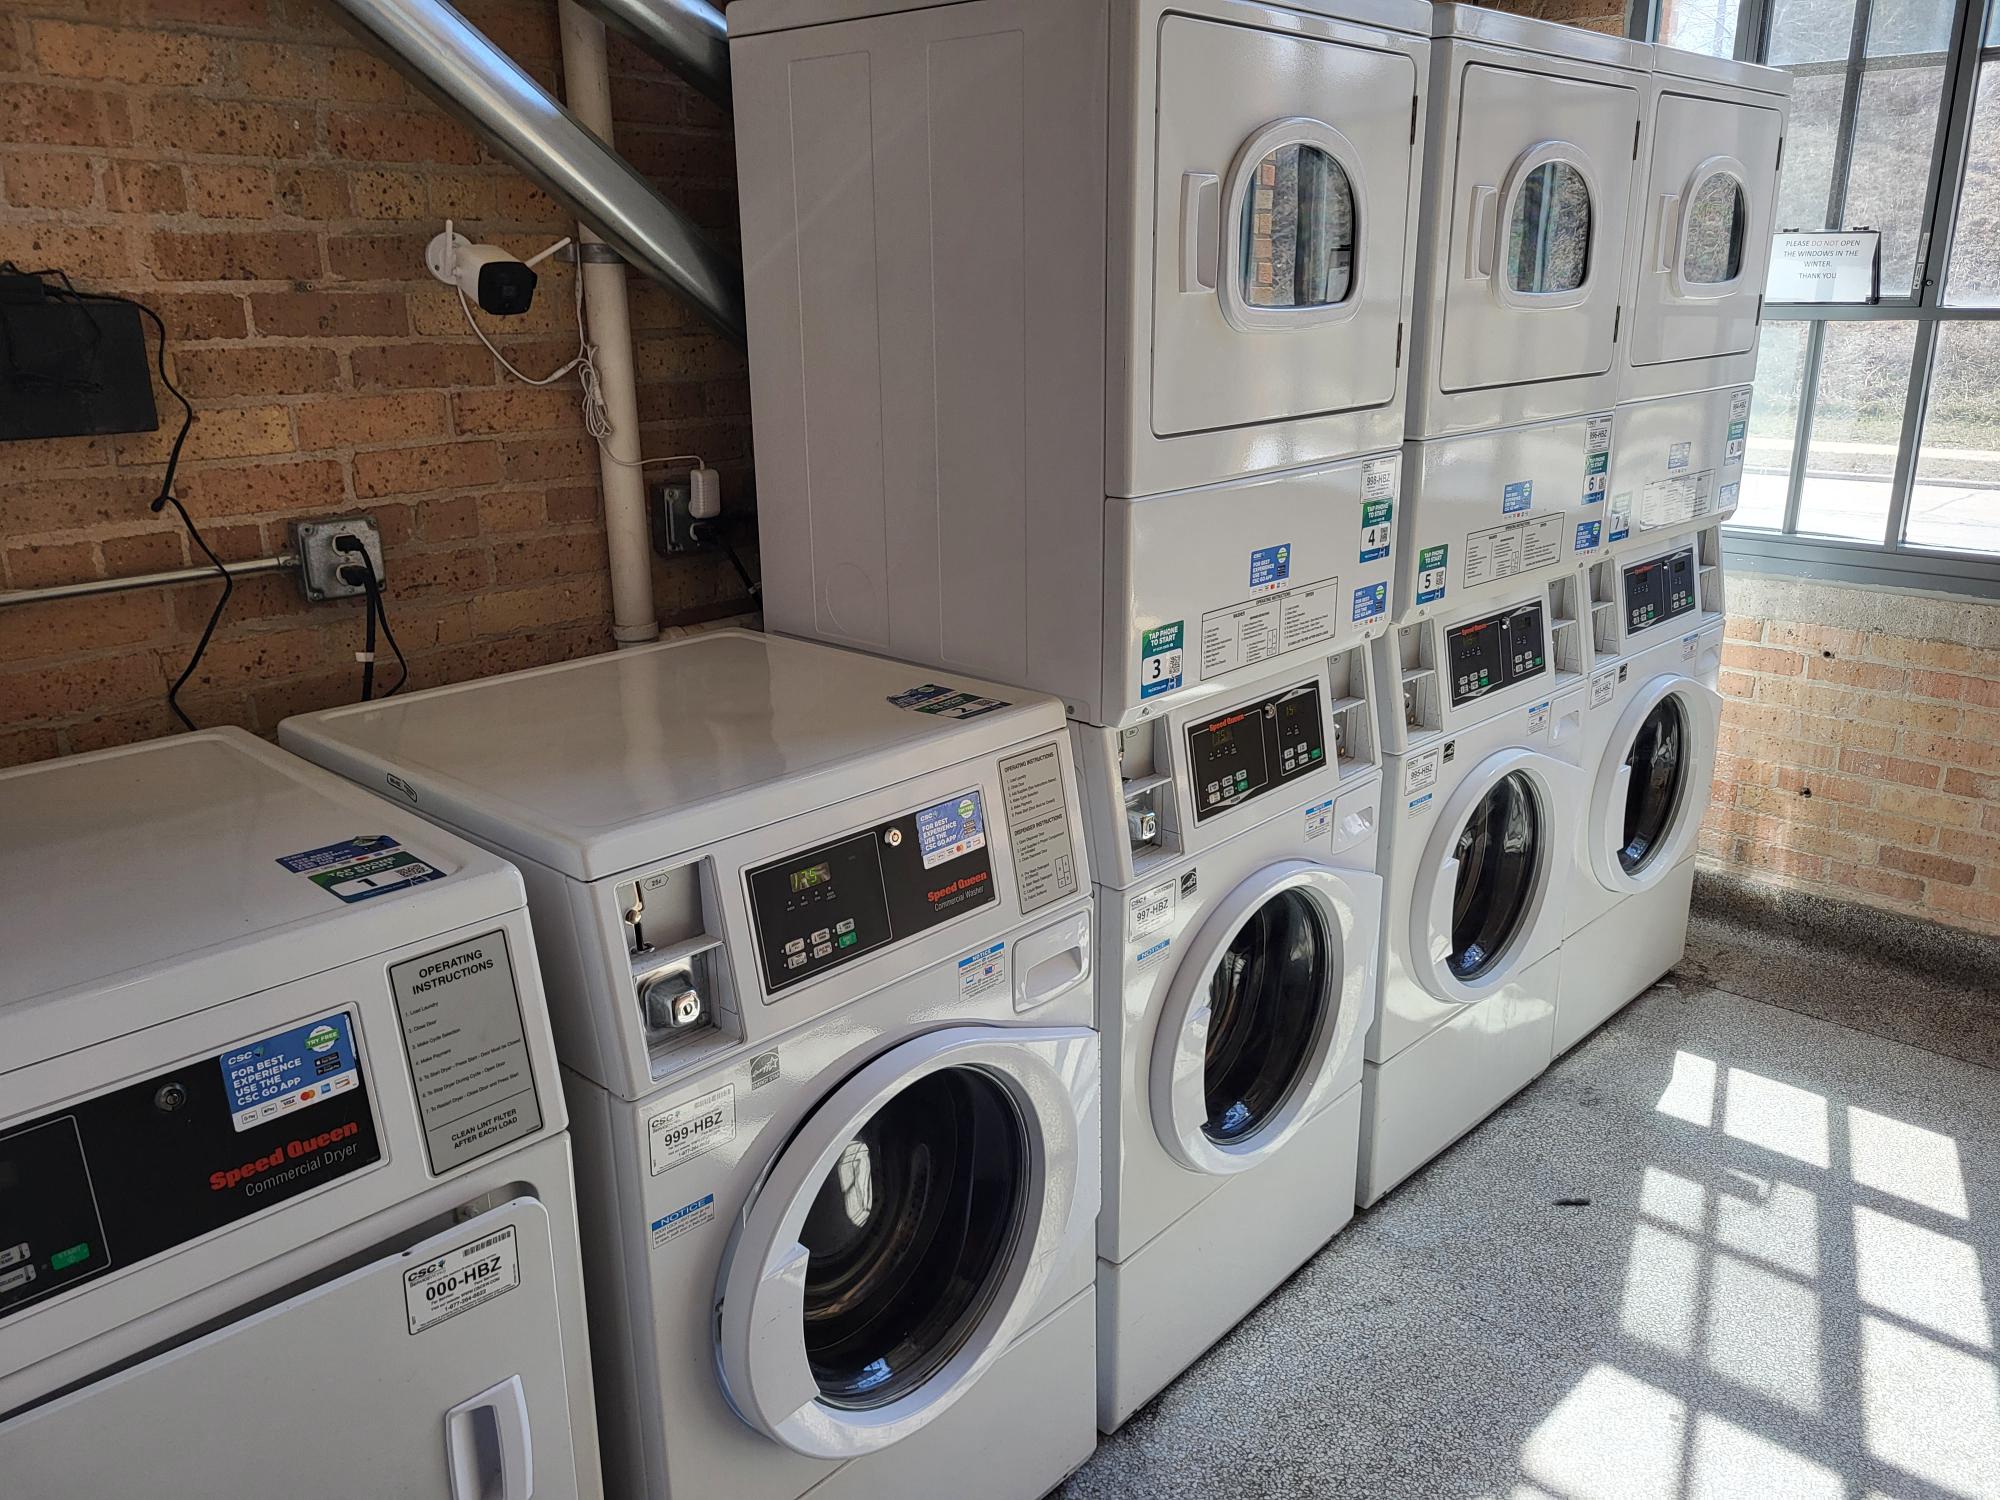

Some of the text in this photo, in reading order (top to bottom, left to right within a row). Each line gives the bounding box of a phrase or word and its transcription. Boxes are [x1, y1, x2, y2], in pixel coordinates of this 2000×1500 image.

[1730, 442, 1734, 454] 8
[1588, 477, 1594, 491] 6
[1616, 516, 1620, 530] 7
[1368, 529, 1375, 546] 4
[1425, 574, 1431, 589] 5
[1149, 626, 1178, 640] TAP PHONE
[1151, 634, 1176, 647] TO START
[1152, 658, 1161, 679] 3
[1209, 714, 1245, 732] Speed Queen
[1004, 752, 1054, 772] OPERATING INSTRUCTIONS
[922, 818, 948, 832] FOR BEST
[923, 821, 957, 839] EXPERIENCE
[1014, 814, 1063, 836] DISPENSER INSTRUCTIONS
[924, 831, 947, 845] USE THE
[925, 835, 957, 851] CSC GO APP
[355, 862, 395, 874] START
[356, 878, 378, 888] 1
[927, 871, 987, 902] Speed Queen
[934, 886, 984, 912] Commercial Washer
[1137, 898, 1169, 922] 997-HBZ
[418, 949, 483, 979] OPERATING
[412, 959, 494, 995] INSTRUCTIONS
[306, 1031, 337, 1047] TRY FREE
[228, 1052, 253, 1066] CSC
[231, 1055, 284, 1079] FOR BEST
[233, 1058, 302, 1089] EXPERIENCE
[235, 1075, 282, 1097] USE THE
[237, 1077, 301, 1106] CSC GO APP
[283, 1097, 295, 1106] VISA
[451, 1108, 517, 1142] CLEAN LINT FILTER
[651, 1112, 673, 1129] CSC
[664, 1111, 723, 1147] 999-HBZ
[454, 1117, 518, 1149] AFTER EACH LOAD
[209, 1121, 359, 1191] Speed Queen
[245, 1142, 358, 1197] Commercial Dryer
[661, 1199, 706, 1226] NOTICE
[408, 1264, 436, 1281] CSC
[426, 1256, 502, 1300] 000-HBZ
